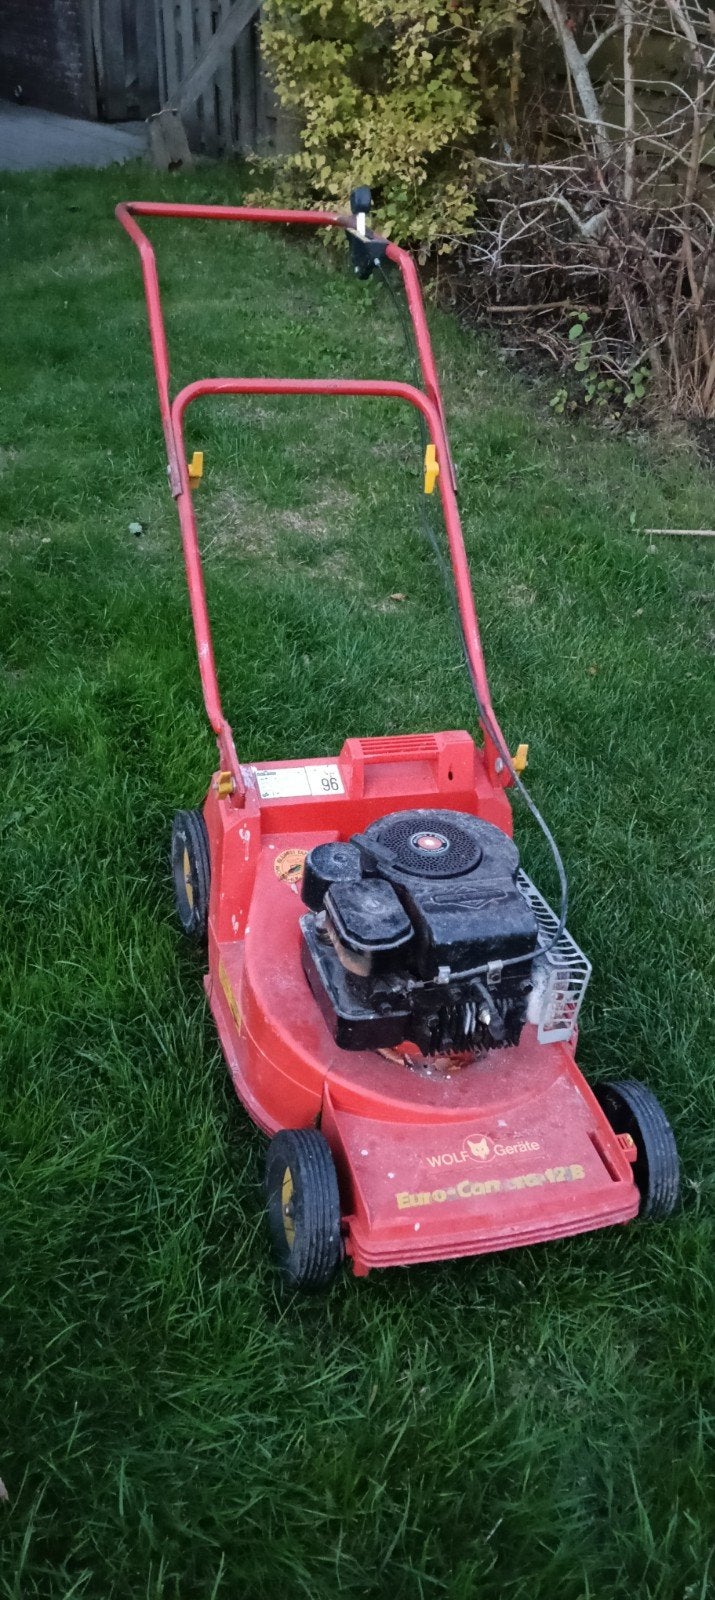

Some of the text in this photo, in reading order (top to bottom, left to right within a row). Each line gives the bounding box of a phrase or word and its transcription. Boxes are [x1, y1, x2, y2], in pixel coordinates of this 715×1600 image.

[321, 777, 339, 792] 96
[426, 1141, 540, 1168] WOLF Geräte
